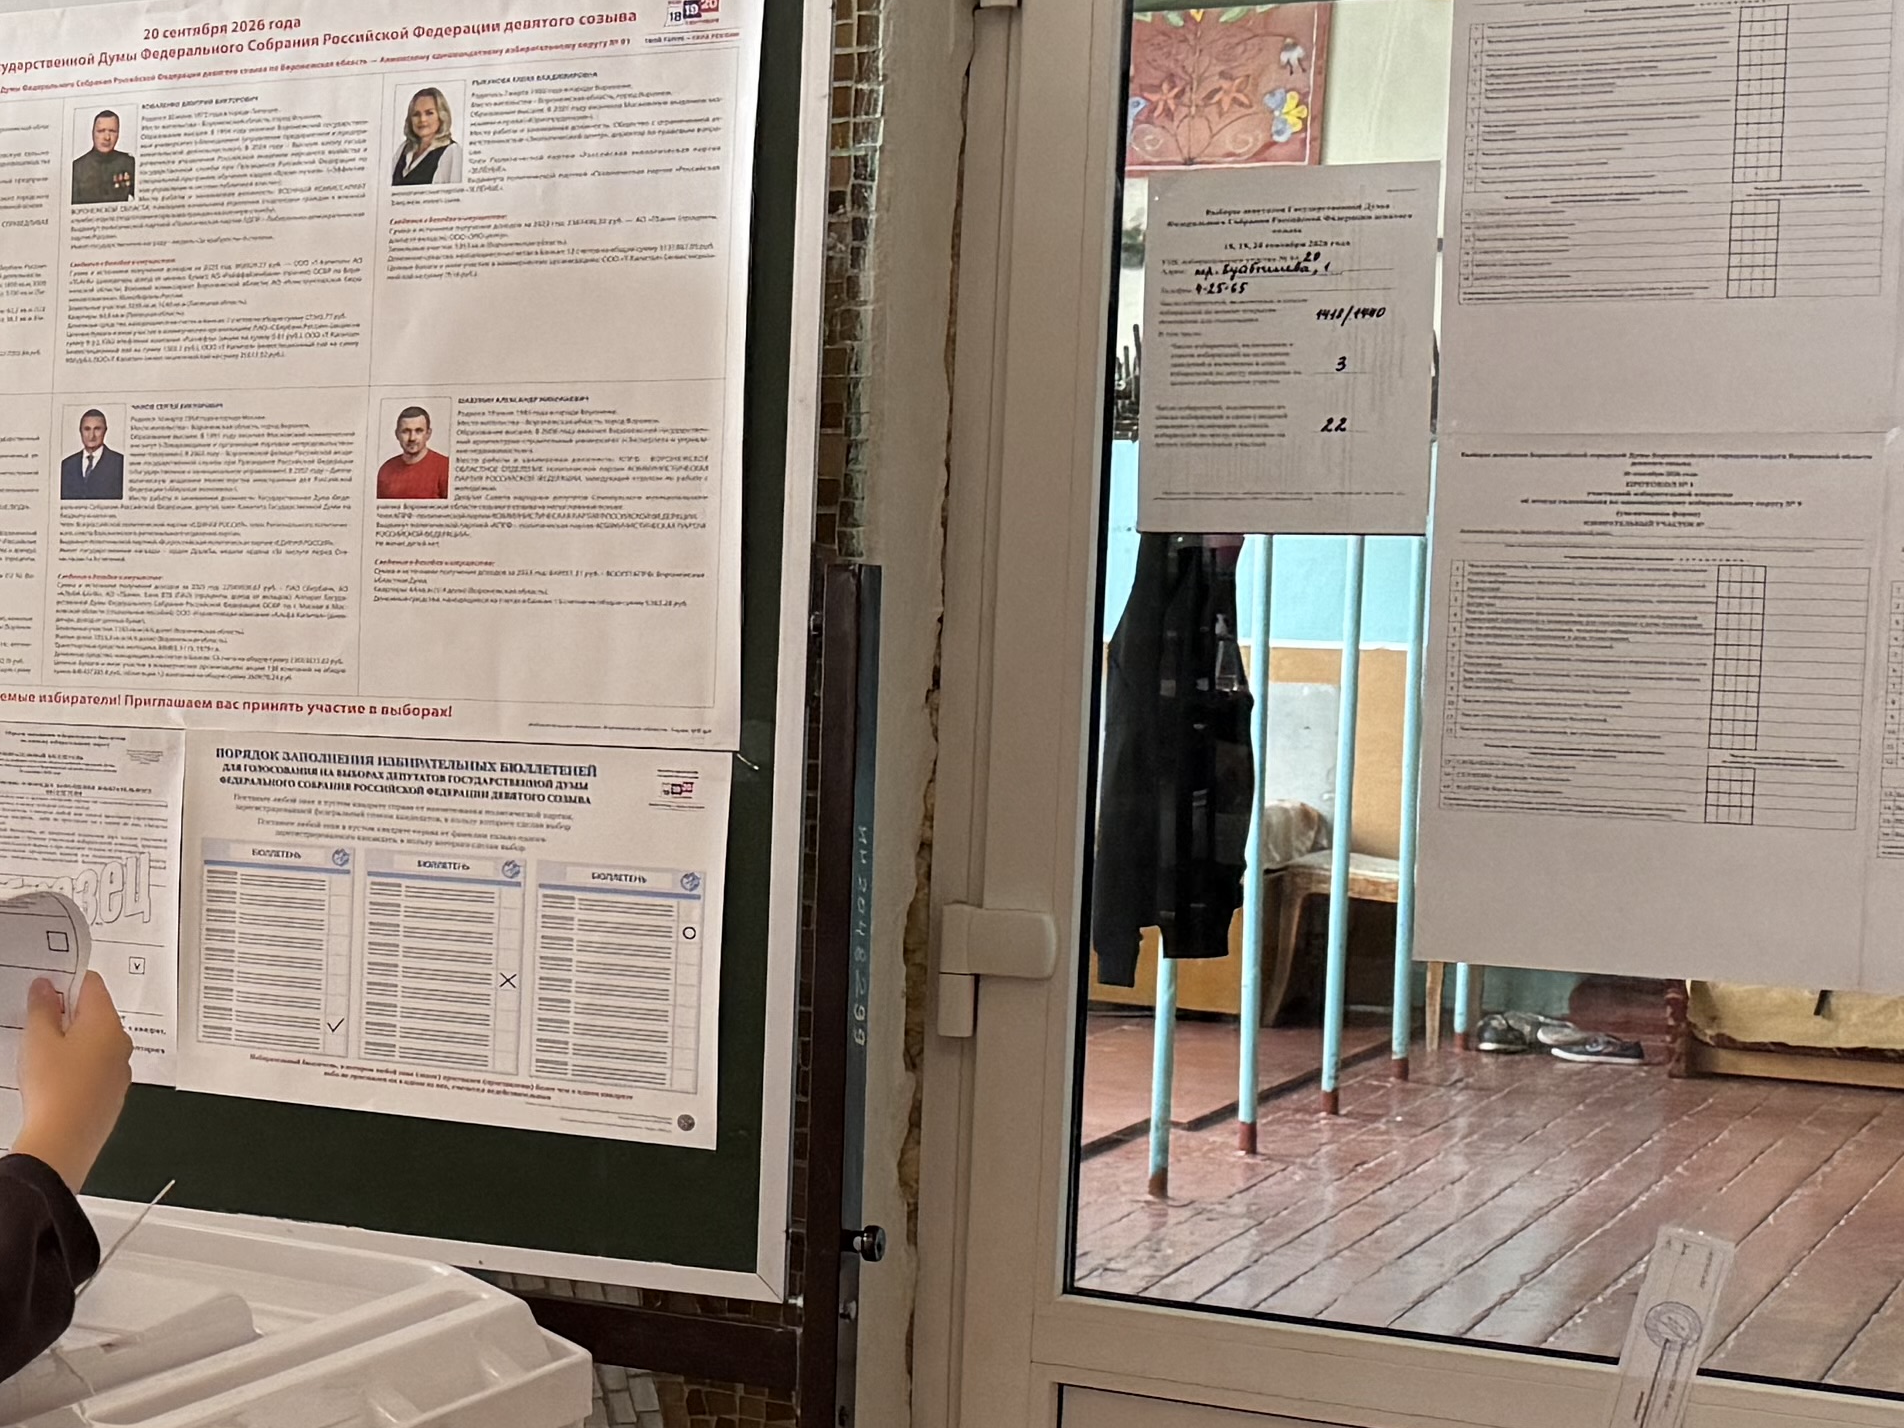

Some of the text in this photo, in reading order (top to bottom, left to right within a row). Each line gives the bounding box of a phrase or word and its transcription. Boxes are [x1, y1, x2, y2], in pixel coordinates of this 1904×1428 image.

[669, 10, 682, 23] 18
[143, 18, 302, 40] 20 сентября 2026 года
[97, 51, 137, 67] Думы
[141, 42, 244, 62] Федерального
[247, 36, 319, 52] Собрания
[323, 27, 409, 46] Российской
[412, 21, 501, 40] Федерации
[504, 16, 574, 33] девятого
[578, 11, 637, 25] созыва
[1335, 355, 1347, 372] 3
[1320, 417, 1348, 432] 22
[39, 691, 121, 707] избиратели!
[124, 694, 213, 710] Приглашаем
[216, 700, 240, 711] вас
[242, 700, 304, 714] принять
[307, 703, 366, 716] участие
[369, 706, 377, 715] в
[381, 704, 453, 720] выборах!
[215, 748, 597, 778] ПОРЯДОК ЗАПОЛНЕНИЯ ИЗБИРАТЕЛЬНЫХ БЮЛЛЕТЕНЕЙ
[353, 782, 424, 796] РОССИЙСКОЙ
[448, 774, 553, 790] ГОСУДАРСТВЕННОЙ
